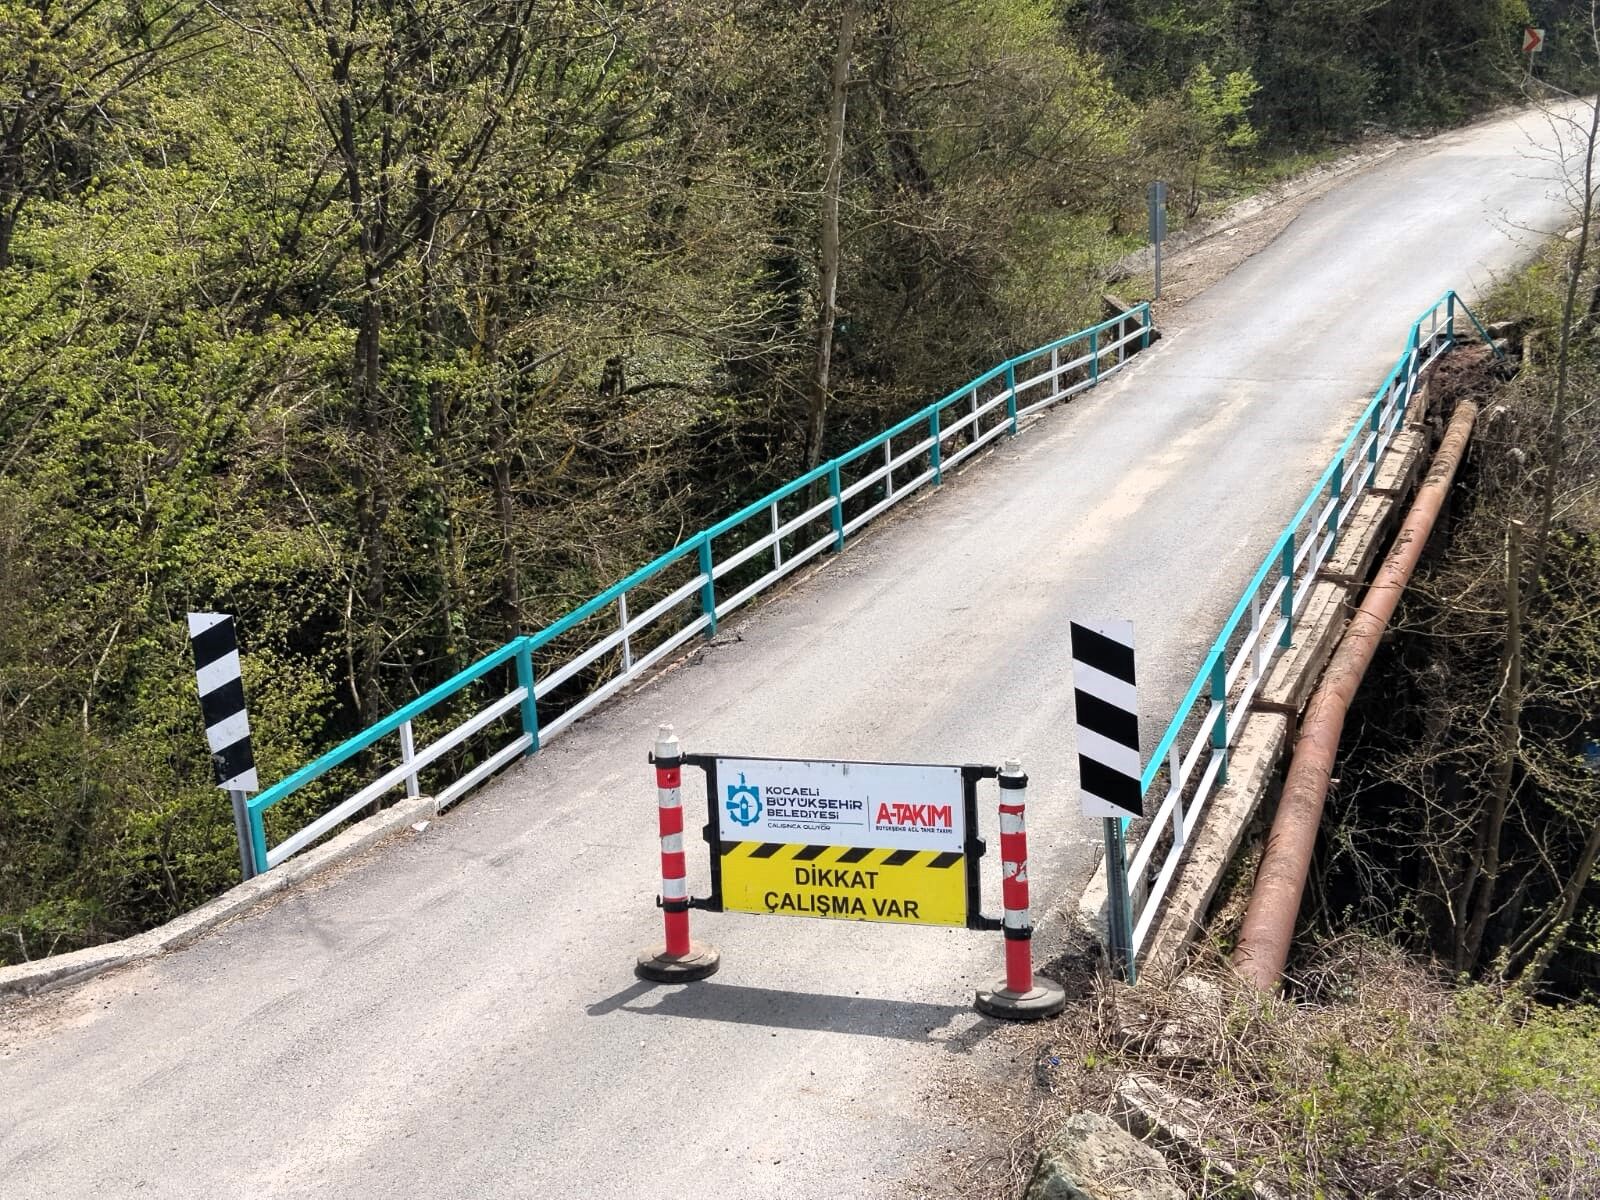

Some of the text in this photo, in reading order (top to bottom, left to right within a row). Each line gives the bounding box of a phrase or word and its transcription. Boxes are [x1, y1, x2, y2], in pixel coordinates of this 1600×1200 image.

[876, 802, 952, 828] A-TAKIMI
[795, 864, 879, 889] DİKKAT
[764, 891, 920, 919] ÇALIŞMA VAR
